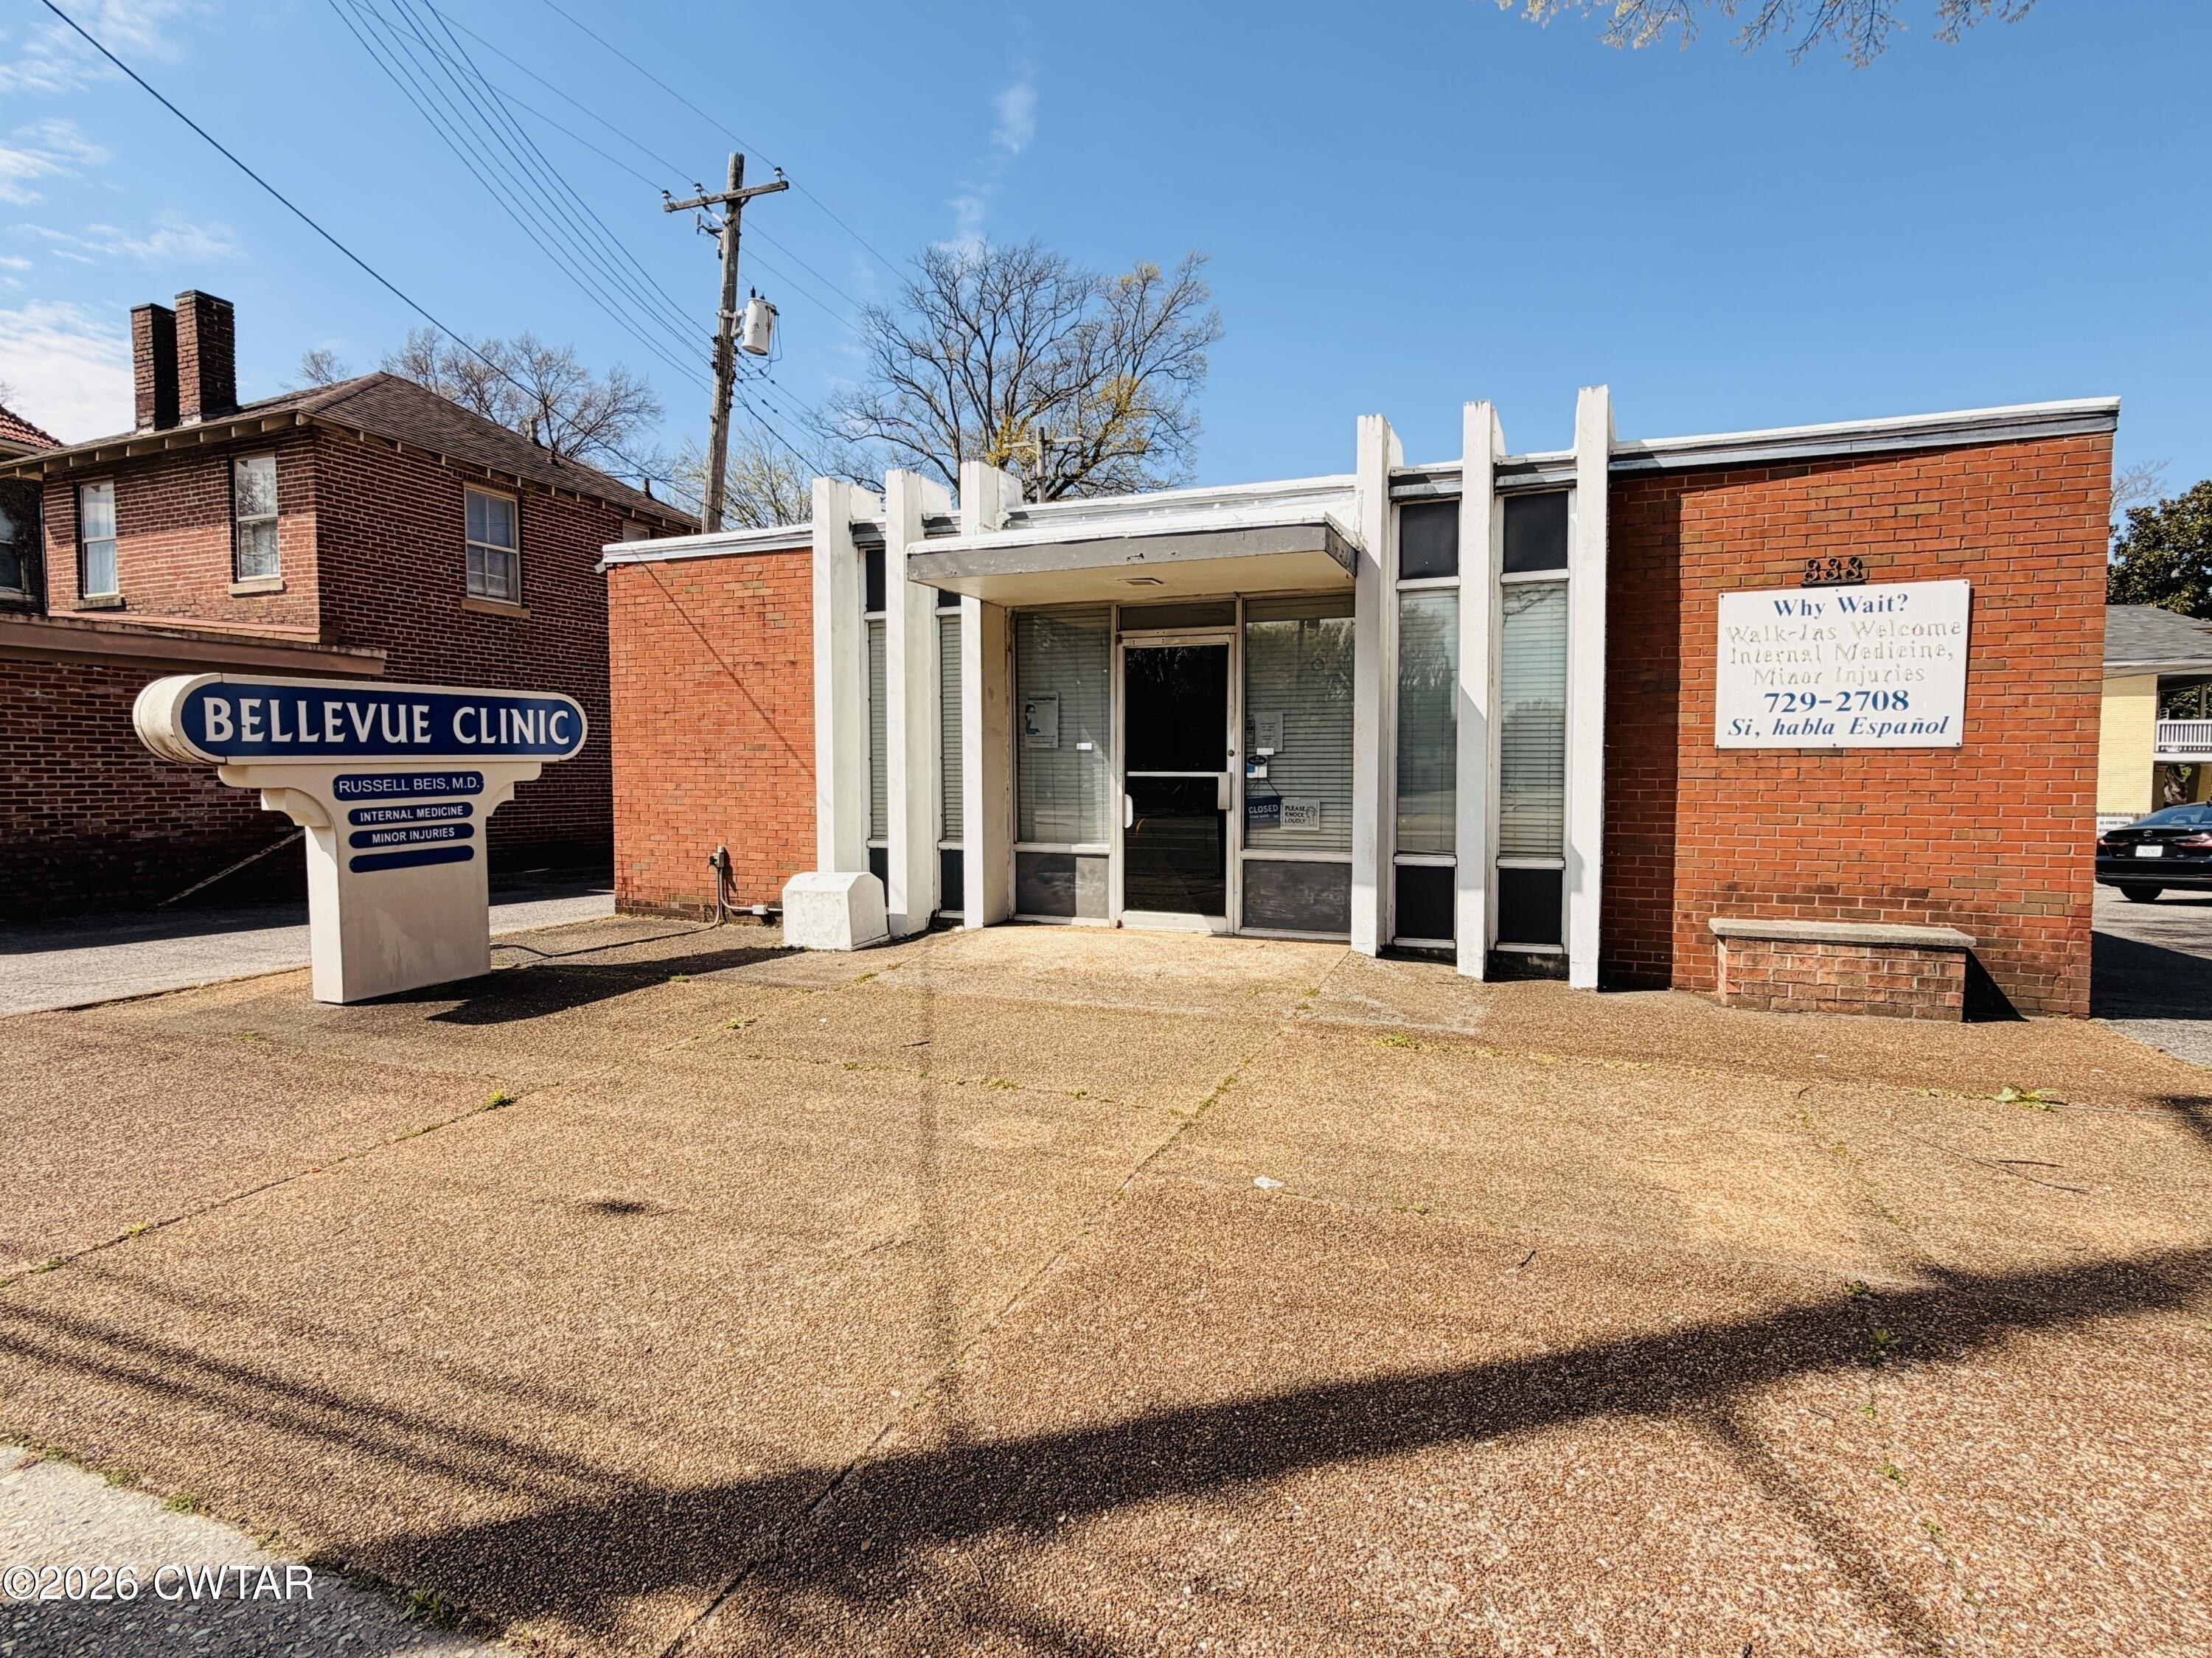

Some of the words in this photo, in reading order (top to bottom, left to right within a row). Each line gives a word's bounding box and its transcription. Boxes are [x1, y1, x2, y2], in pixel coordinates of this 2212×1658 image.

[1773, 599, 1826, 619] Why
[1837, 593, 1908, 614] Wait?
[1725, 625, 1837, 646] Walk-Ins
[1848, 620, 1962, 641] Welcome
[1730, 644, 1822, 664] Internal
[1835, 641, 1953, 661] Medicine,
[1753, 667, 1823, 687] Minor
[1836, 664, 1925, 686] Injuries
[1764, 689, 1910, 714] 729-2708
[203, 697, 432, 744] BELLEVUE
[452, 706, 570, 745] CLINIC
[1772, 718, 1835, 736] habla
[1849, 716, 1950, 738] Español
[339, 779, 410, 793] RUSSELL
[414, 778, 450, 790] BEIS,
[452, 777, 480, 789] M.D.
[360, 809, 414, 822] INTERNAL
[417, 806, 463, 818] MEDICINE
[1248, 805, 1278, 814] CLOSED
[372, 832, 406, 844] MINOR
[410, 827, 455, 840] INJURIES
